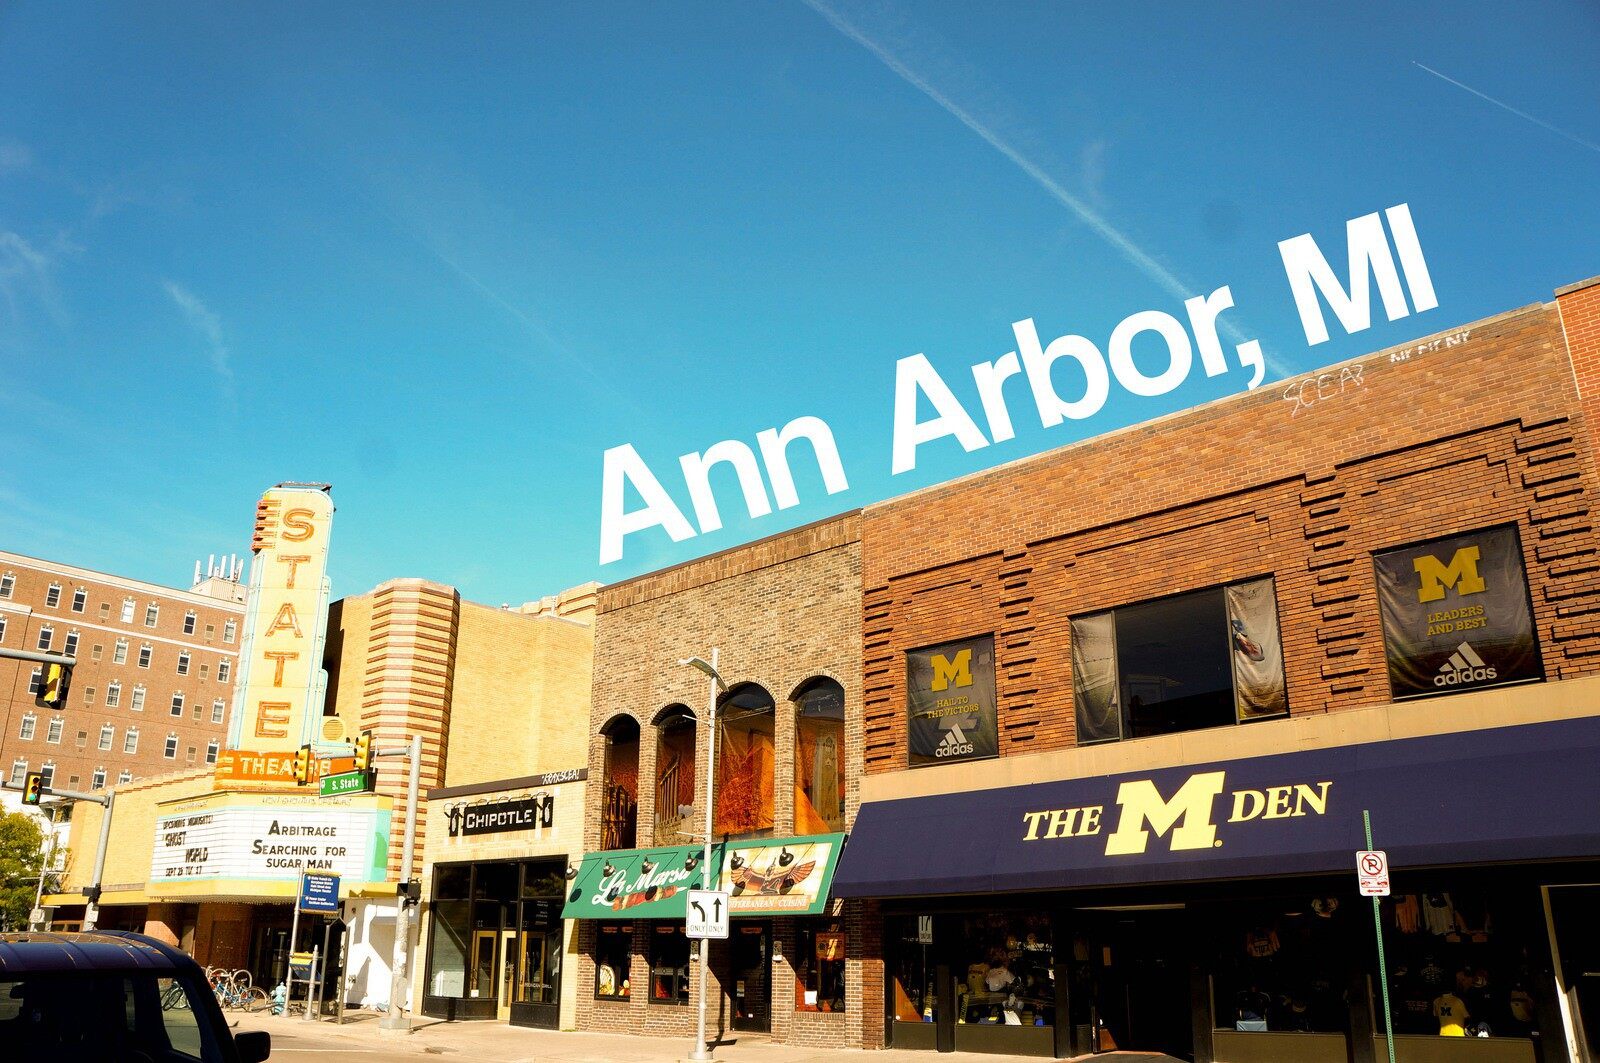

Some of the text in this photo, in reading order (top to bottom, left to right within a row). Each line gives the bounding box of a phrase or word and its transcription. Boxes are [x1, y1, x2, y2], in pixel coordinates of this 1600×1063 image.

[1412, 545, 1486, 604] M
[254, 507, 315, 738] STATE
[1427, 605, 1484, 624] LEADERS
[1427, 617, 1488, 636] AND BEST
[930, 648, 973, 692] M
[1433, 667, 1498, 687] adidas
[927, 703, 979, 719] THE VICTORS
[937, 696, 969, 708] HAIL TO
[935, 743, 974, 758] adidas
[331, 778, 359, 791] S. State
[466, 809, 533, 829] CHIPOTLE
[1022, 771, 1333, 856] THE M DEN
[268, 820, 337, 837] ARBITRAGE
[252, 839, 347, 857] SEARCHING FOR
[266, 858, 333, 870] SUGAR MAN
[591, 869, 627, 907] La
[778, 897, 807, 908] CUISINE
[690, 924, 724, 934] ONLY ONLY
